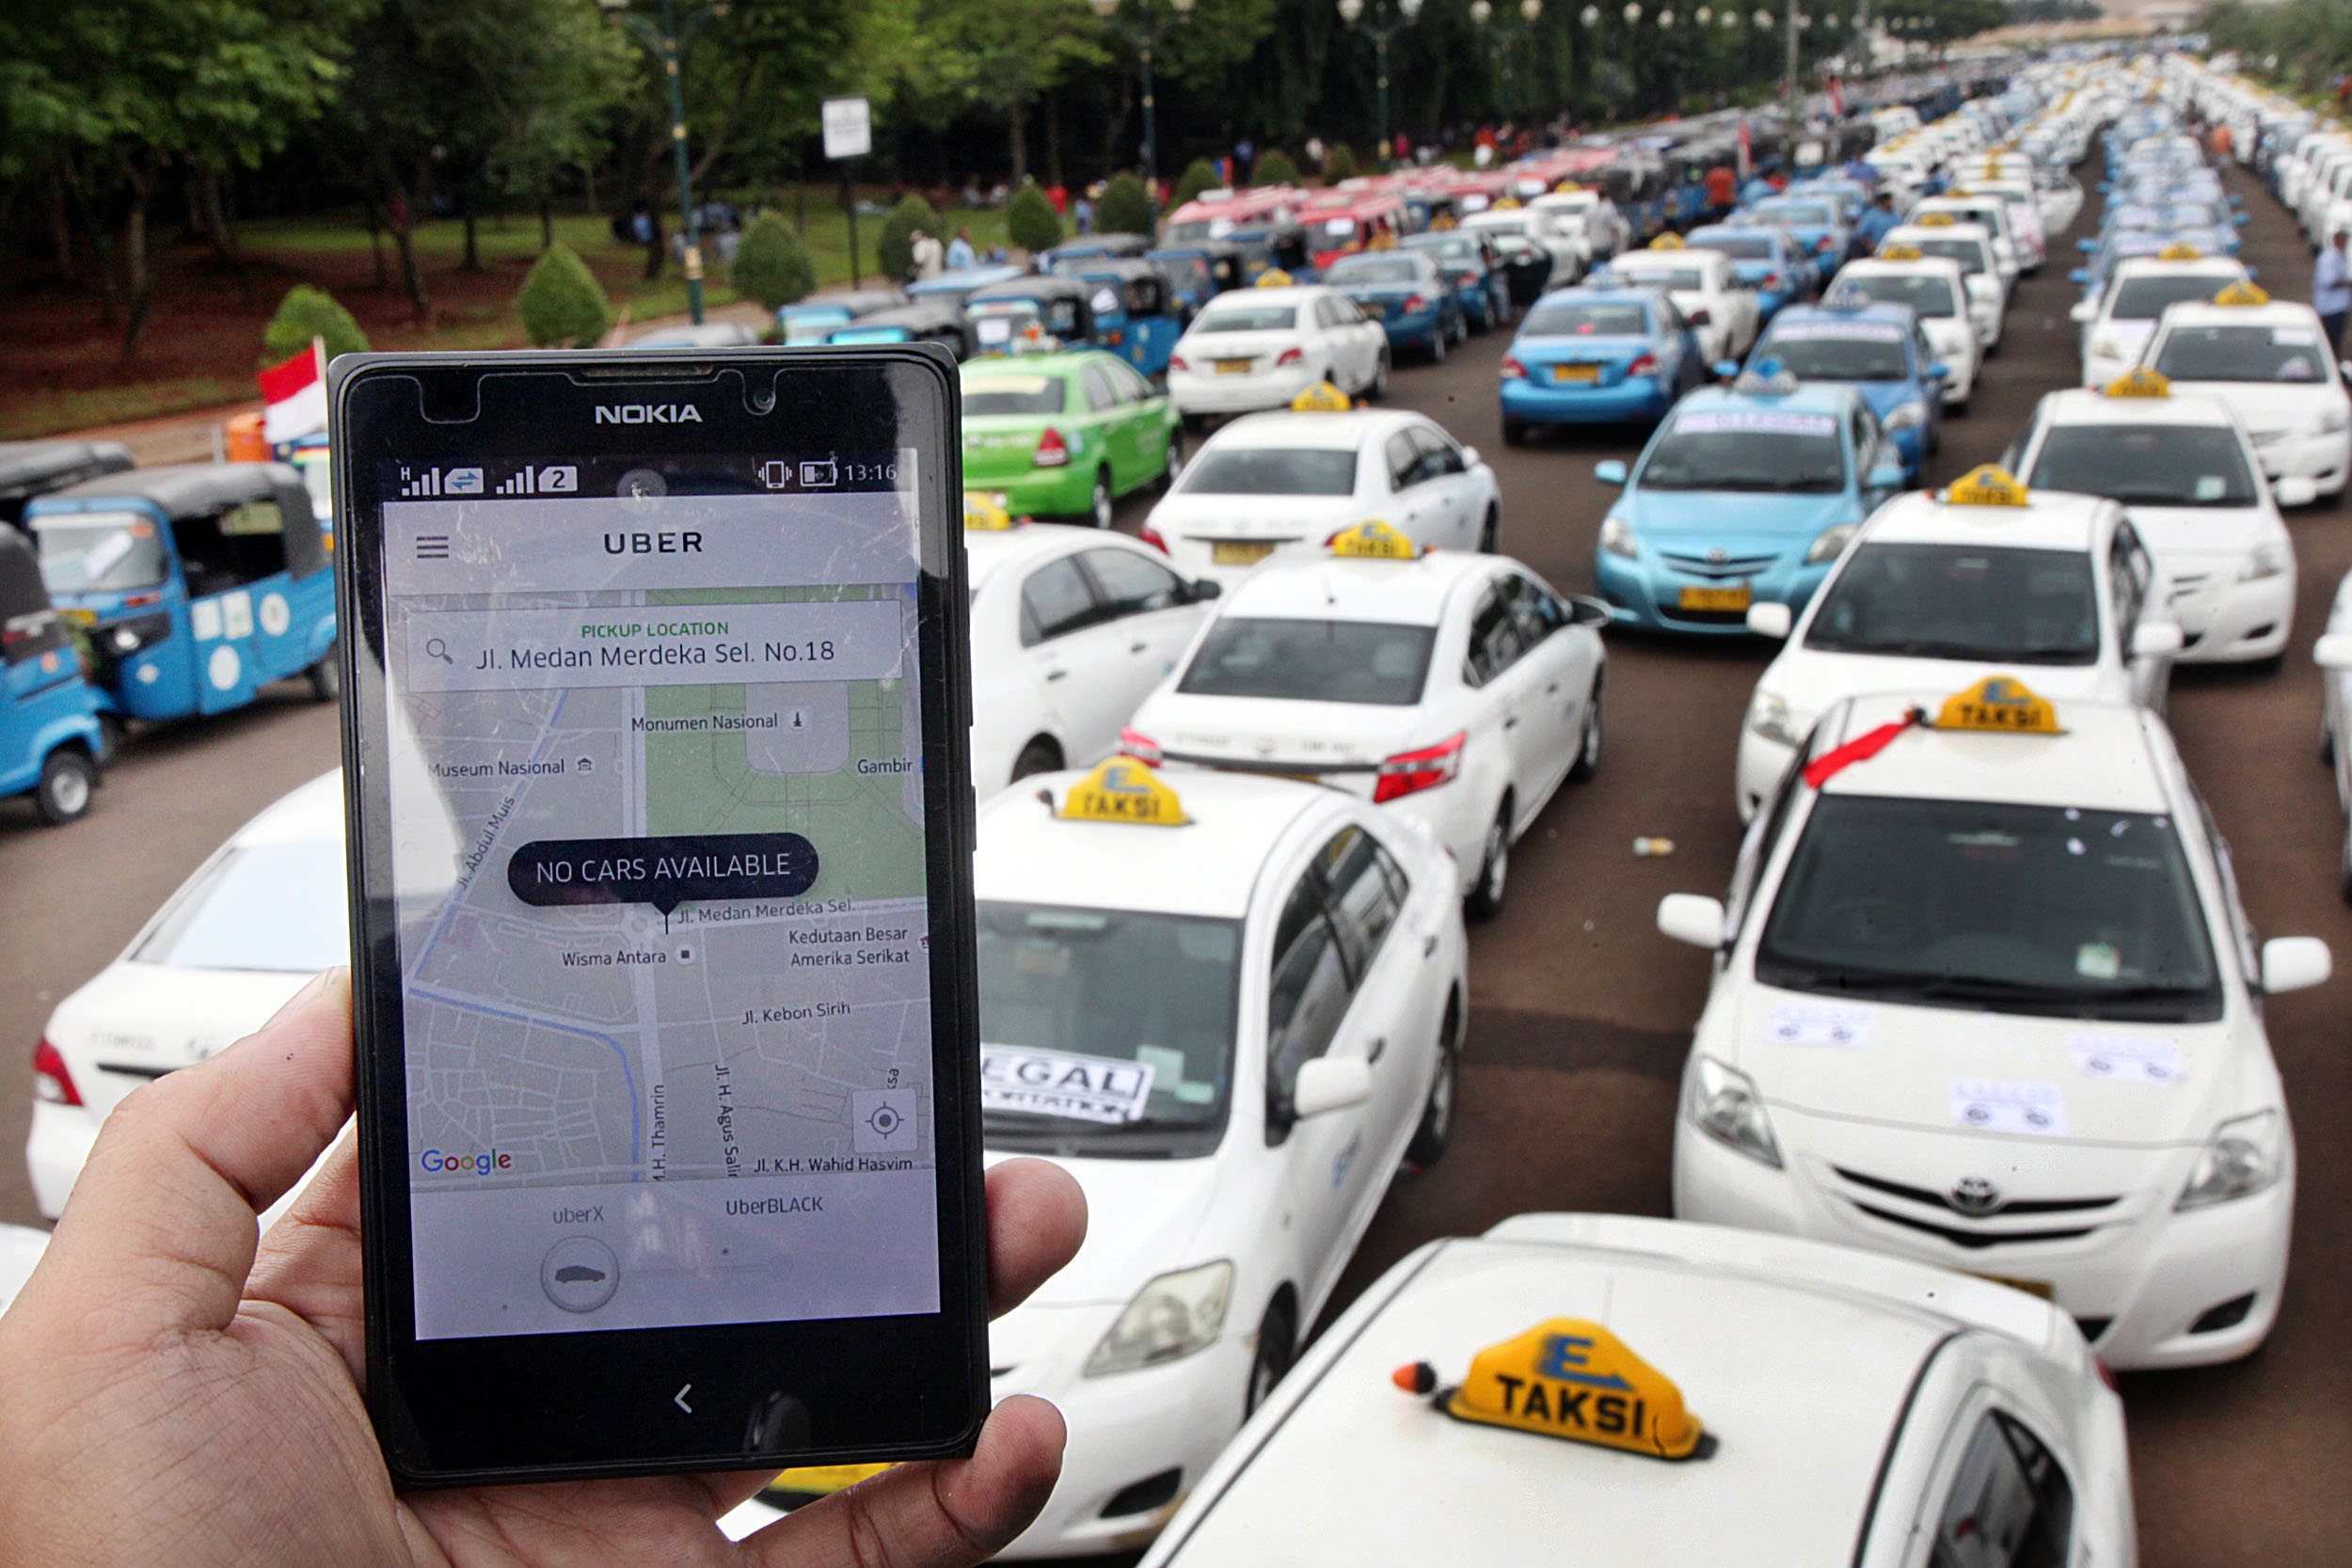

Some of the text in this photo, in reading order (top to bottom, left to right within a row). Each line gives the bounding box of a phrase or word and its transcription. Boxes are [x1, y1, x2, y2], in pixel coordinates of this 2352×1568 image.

[595, 404, 703, 424] NOKIA
[552, 470, 565, 489] 2
[844, 464, 898, 481] 13:16
[604, 531, 703, 554] UBER
[580, 621, 730, 639] PICKUP LOCATION
[475, 641, 835, 670] Jl. Medan Merdeka Sel. No.18
[631, 712, 778, 732] Monumen Nasional
[428, 758, 565, 779] Museum Nasional
[857, 756, 914, 775] Gambir
[1083, 795, 1162, 818] TAKSI
[465, 828, 497, 874] Abdul
[486, 796, 516, 832] Muis
[535, 852, 792, 884] NO CARS AVAILABLE
[698, 907, 752, 923] Medan
[755, 900, 824, 918] Merdeka
[828, 897, 856, 913] Sel.
[788, 927, 909, 944] Kedutaan Besar
[562, 949, 667, 967] Wisma Antara
[790, 948, 911, 967] Amerika Serikat
[763, 1006, 813, 1023] Kebon
[816, 1000, 851, 1017] Sirih
[650, 1085, 665, 1149] Thamrin
[717, 1104, 734, 1143] Agus
[421, 1148, 512, 1176] Google
[774, 1157, 804, 1172] K.H.
[808, 1156, 854, 1172] Wahid
[552, 1204, 605, 1224] uberX
[725, 1196, 823, 1216] UberBLACK
[1495, 1372, 1645, 1437] TAKSI
